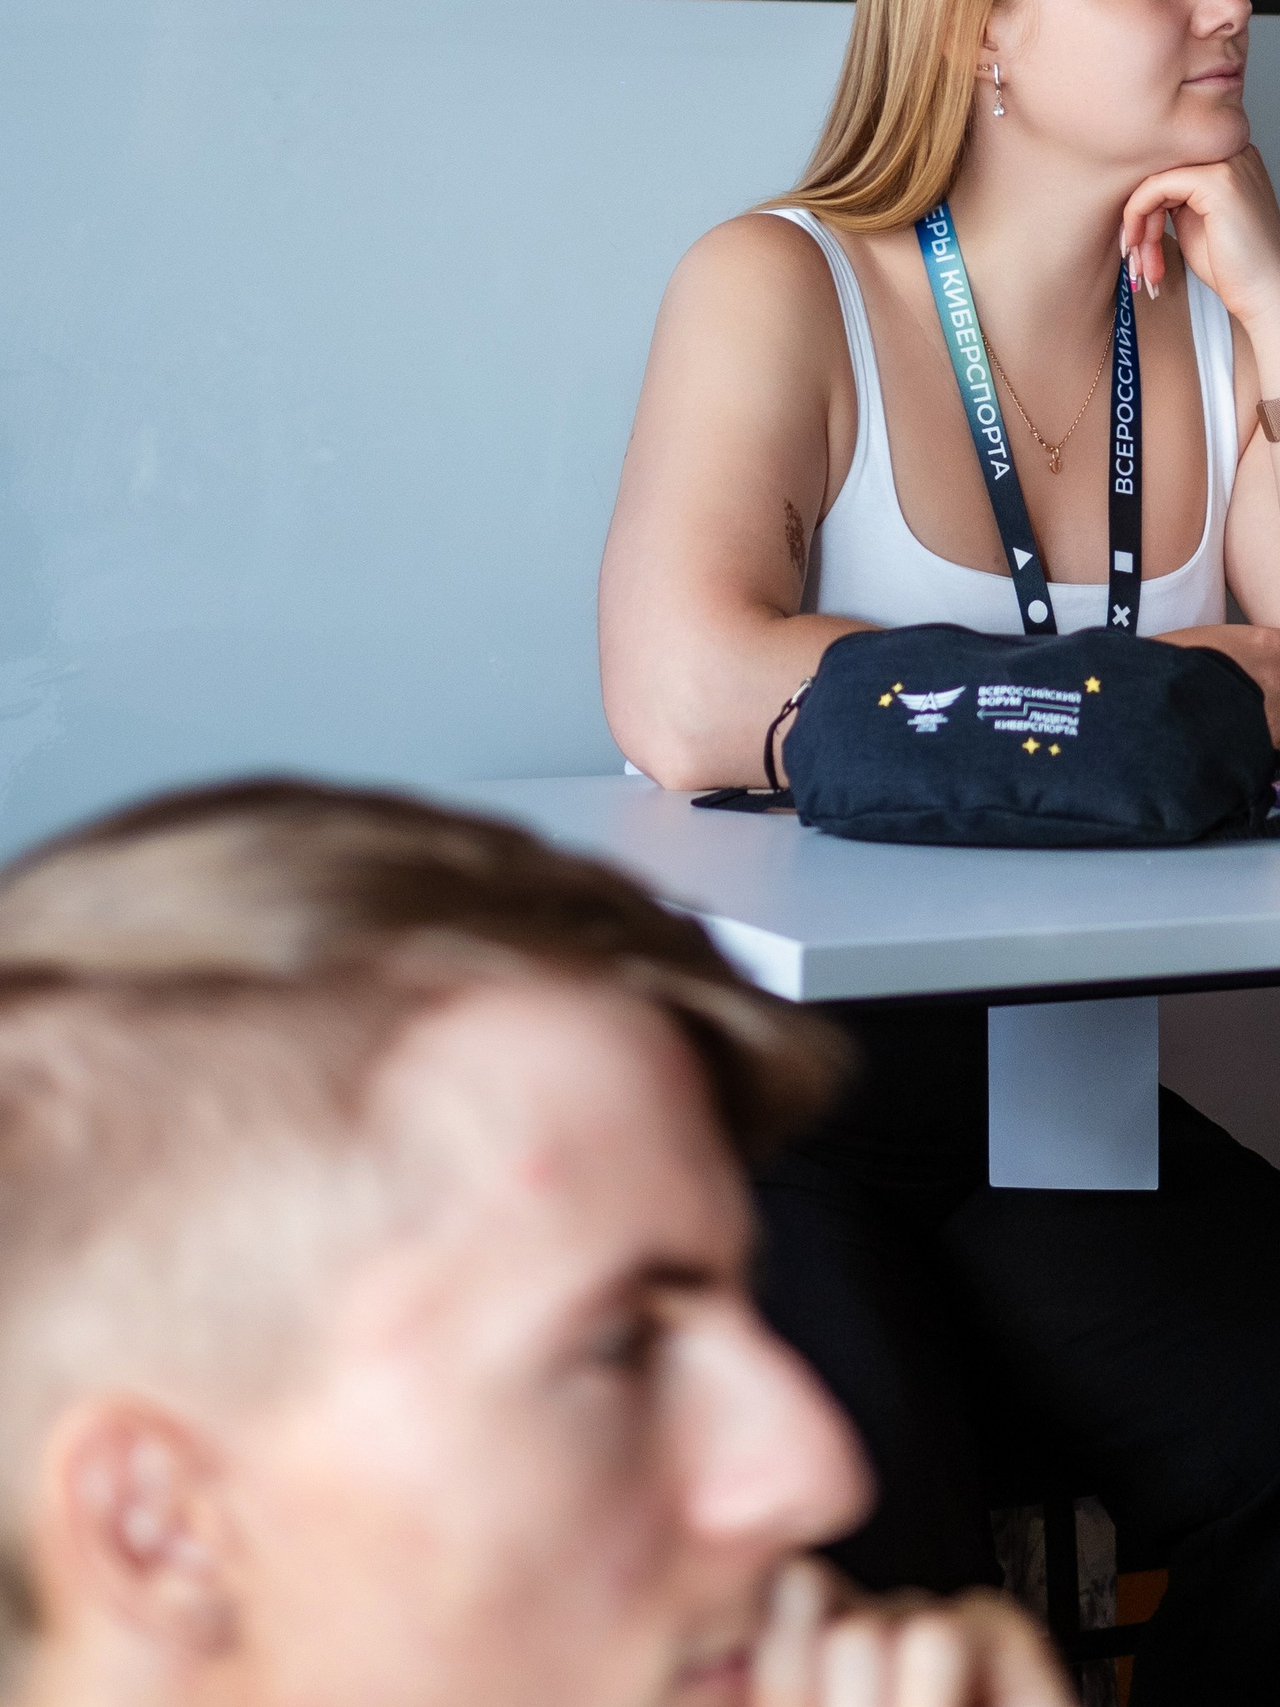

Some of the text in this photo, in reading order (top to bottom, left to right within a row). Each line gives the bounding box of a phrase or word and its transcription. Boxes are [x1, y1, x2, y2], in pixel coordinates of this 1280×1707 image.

[938, 267, 1011, 481] КИБЕРСПОРТА
[977, 685, 1082, 704] ВСЕРОССИЙСКИЙ
[977, 696, 1022, 707] ФОРУМ
[993, 719, 1079, 737] КИБЕРСПОРТА
